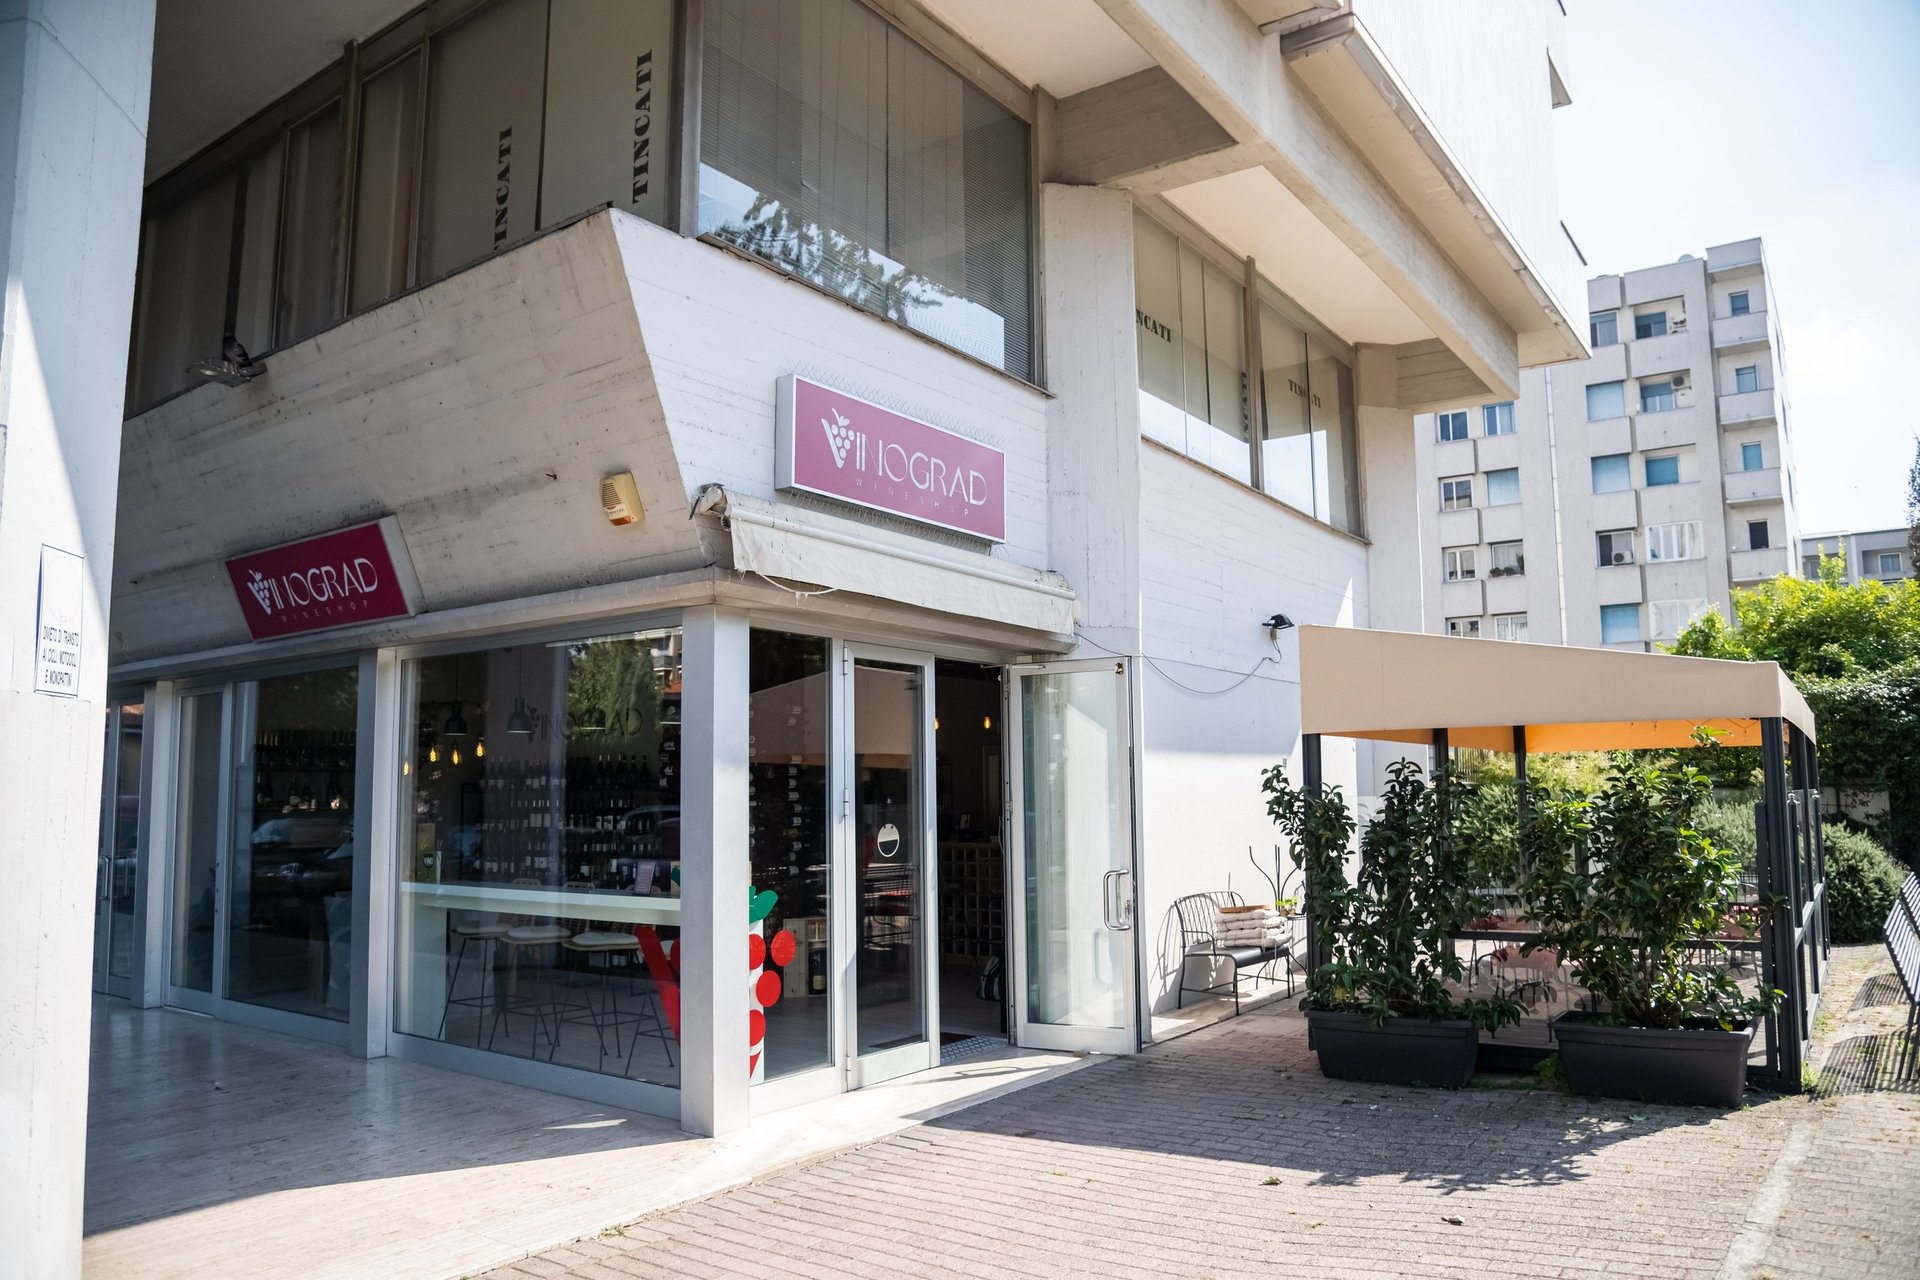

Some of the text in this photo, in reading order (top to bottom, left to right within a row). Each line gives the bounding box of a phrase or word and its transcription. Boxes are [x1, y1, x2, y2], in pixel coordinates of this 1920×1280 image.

[632, 48, 652, 204] TINCATI
[494, 125, 512, 250] INCATI
[821, 408, 988, 506] VINOGRAD
[247, 557, 378, 615] VINOGRAD
